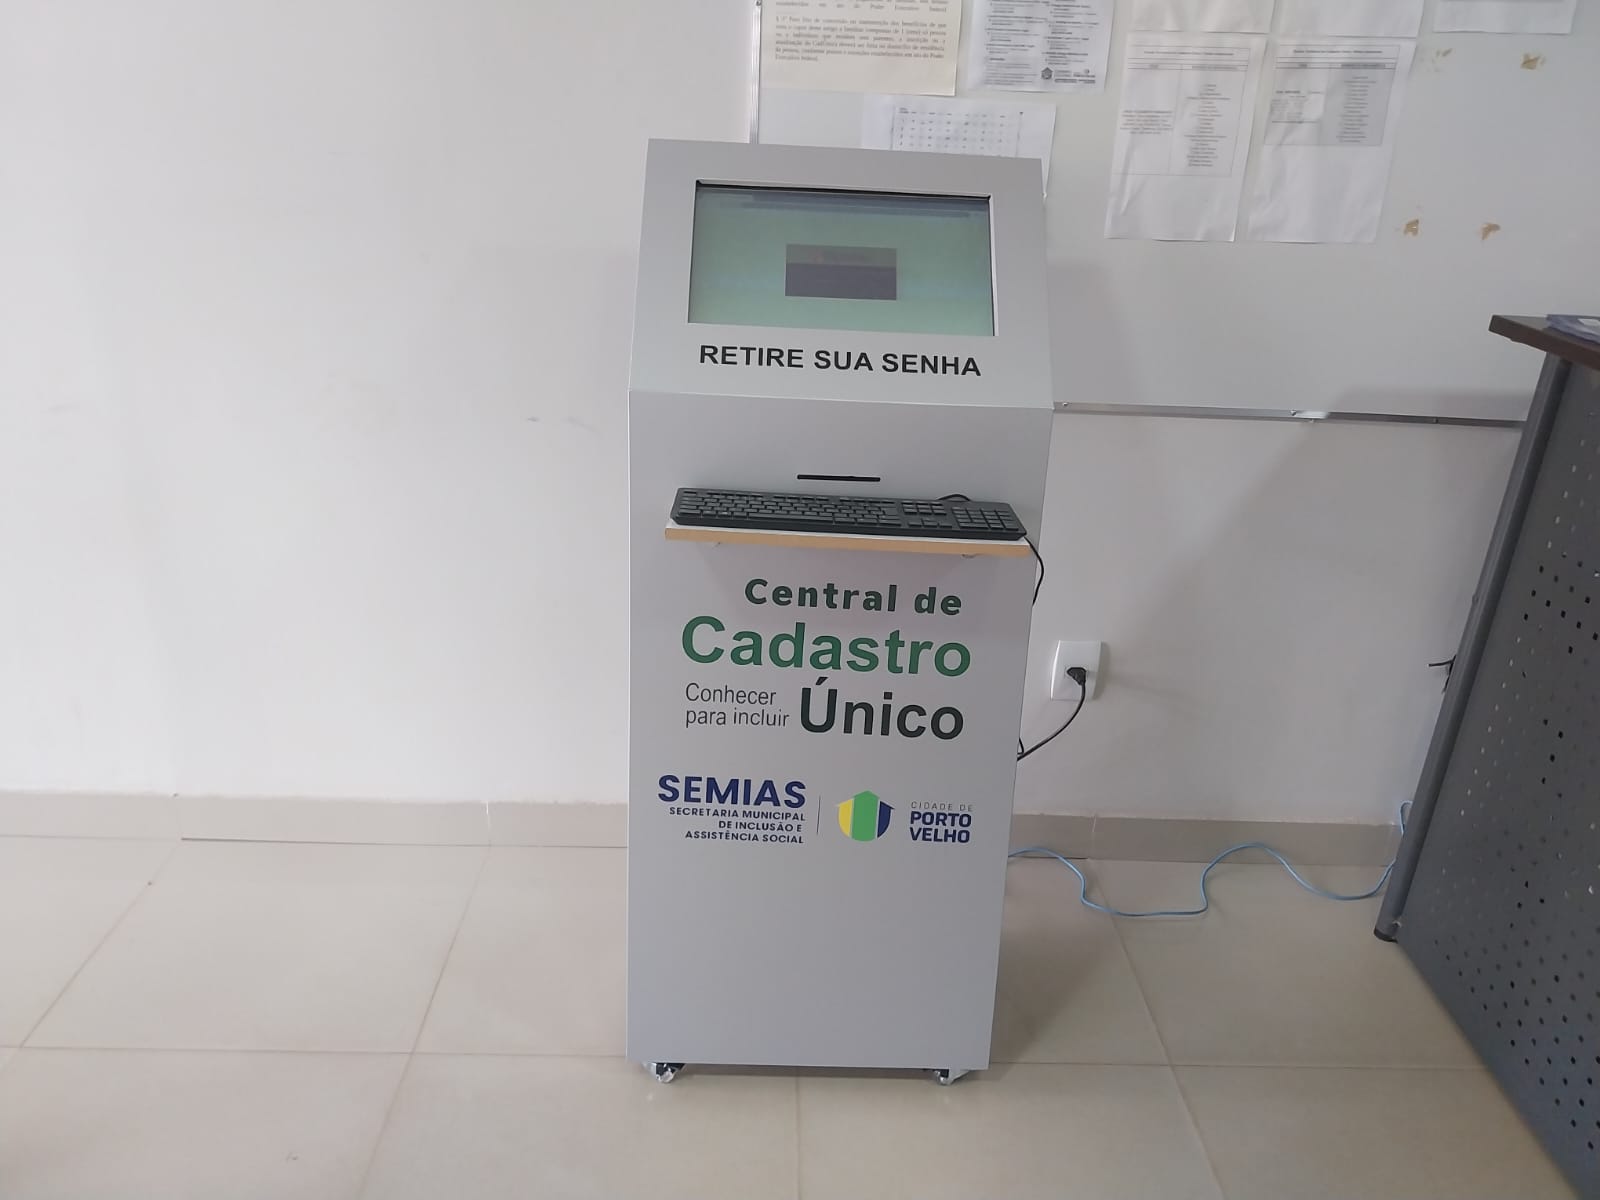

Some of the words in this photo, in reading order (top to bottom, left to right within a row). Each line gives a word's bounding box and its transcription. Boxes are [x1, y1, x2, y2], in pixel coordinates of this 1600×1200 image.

[700, 344, 804, 368] RETIRE
[814, 350, 873, 371] SUA
[881, 353, 981, 376] SENHA
[744, 578, 897, 612] Central
[914, 587, 962, 616] de
[682, 615, 971, 677] Cadastro
[685, 682, 777, 706] Conhecer
[685, 707, 727, 729] para
[732, 707, 790, 728] incluir
[800, 676, 964, 740] Único
[658, 775, 806, 808] SEMIAS
[669, 806, 740, 818] SECRETARIA
[742, 810, 806, 822] MUNICIPAL
[911, 801, 953, 811] CIDADE
[959, 804, 974, 812] DE
[718, 820, 733, 829] DE
[735, 821, 794, 833] INCLUSÃO
[796, 824, 803, 833] E
[911, 811, 972, 827] PORTO
[685, 830, 760, 842] ASSISTÊNCIA
[762, 834, 804, 844] SOCIAL
[910, 827, 970, 843] VELHO
